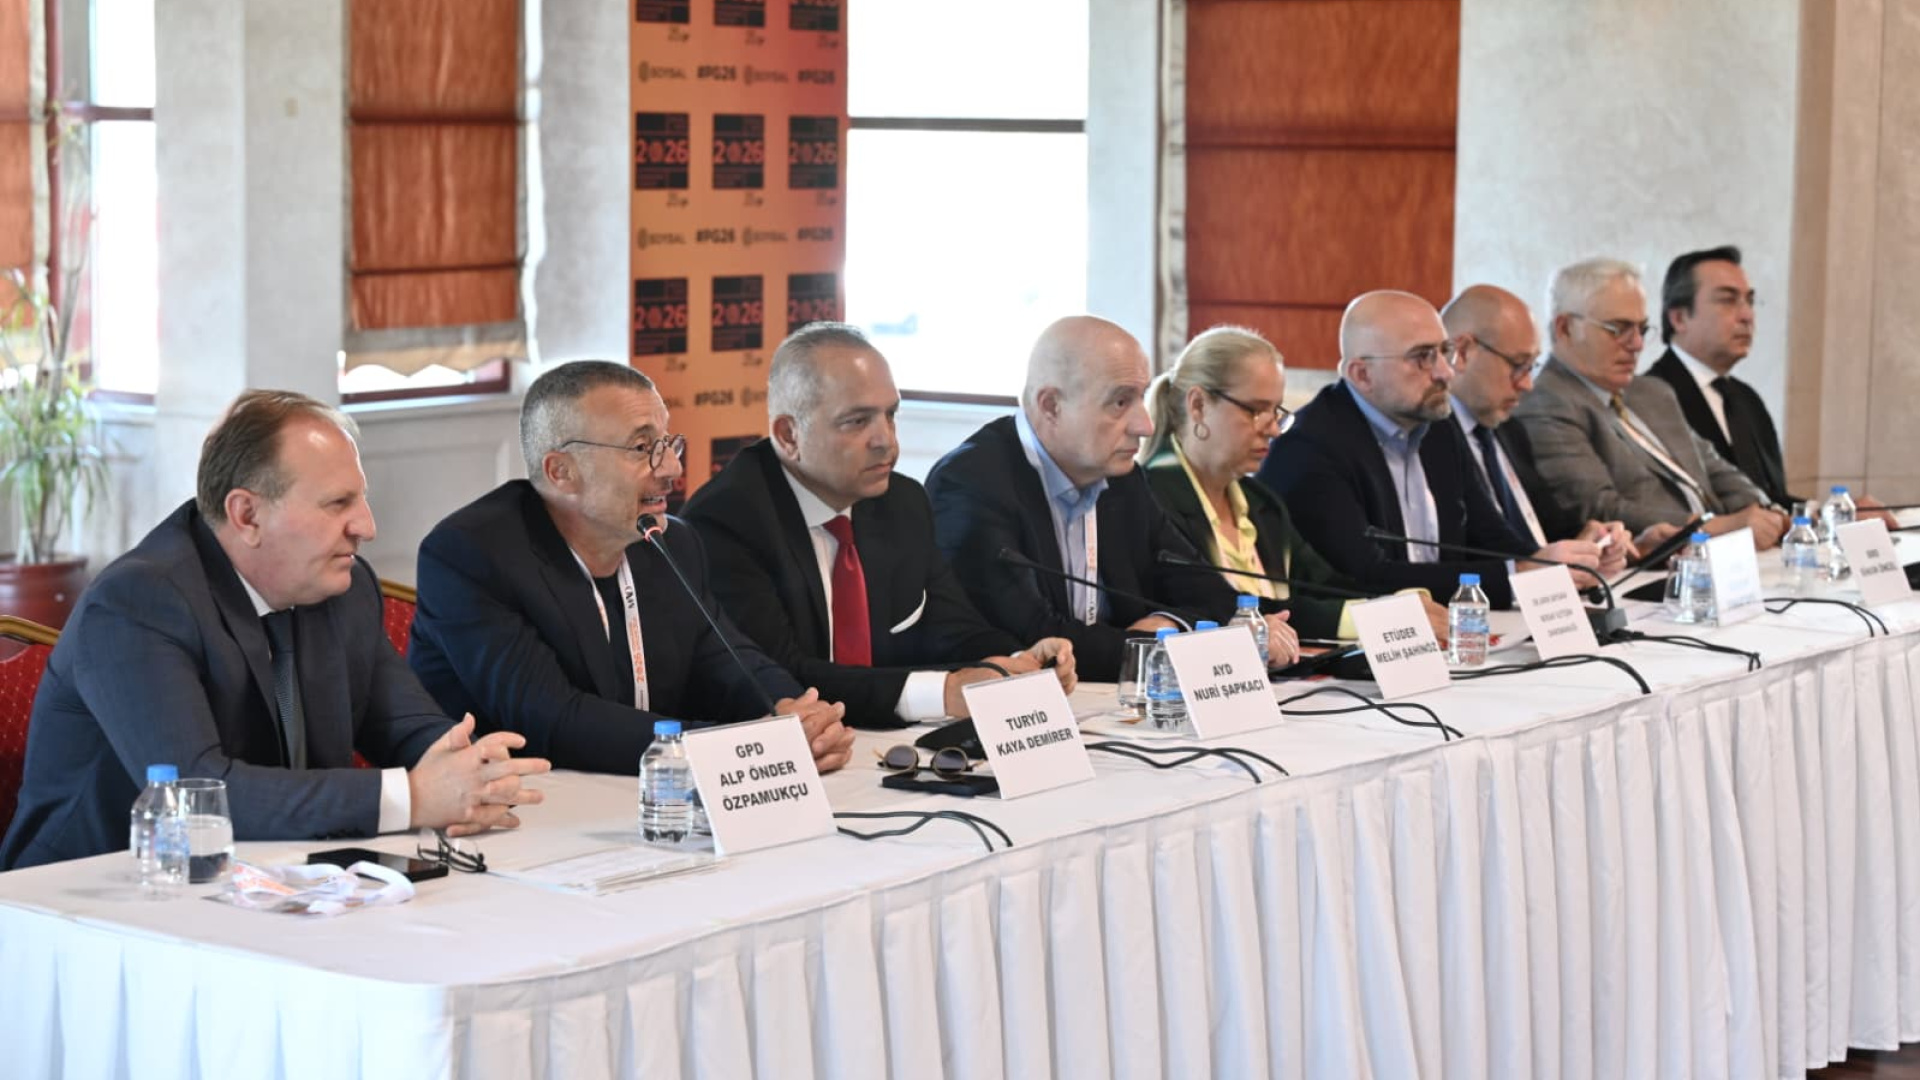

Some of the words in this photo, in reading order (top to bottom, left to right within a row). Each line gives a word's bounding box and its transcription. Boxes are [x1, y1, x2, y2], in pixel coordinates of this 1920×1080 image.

[1212, 663, 1233, 677] AYD
[1193, 683, 1221, 701] NURİ
[1221, 679, 1265, 701] ŞAPKACI
[1006, 710, 1048, 731] TURYİD
[735, 741, 765, 759] GPD
[997, 740, 1026, 757] KAYA
[1026, 727, 1074, 750] DEMİRER
[720, 768, 745, 787] ALP
[749, 760, 797, 782] ÖNDER
[722, 782, 809, 812] ÖZPAMUKÇU
